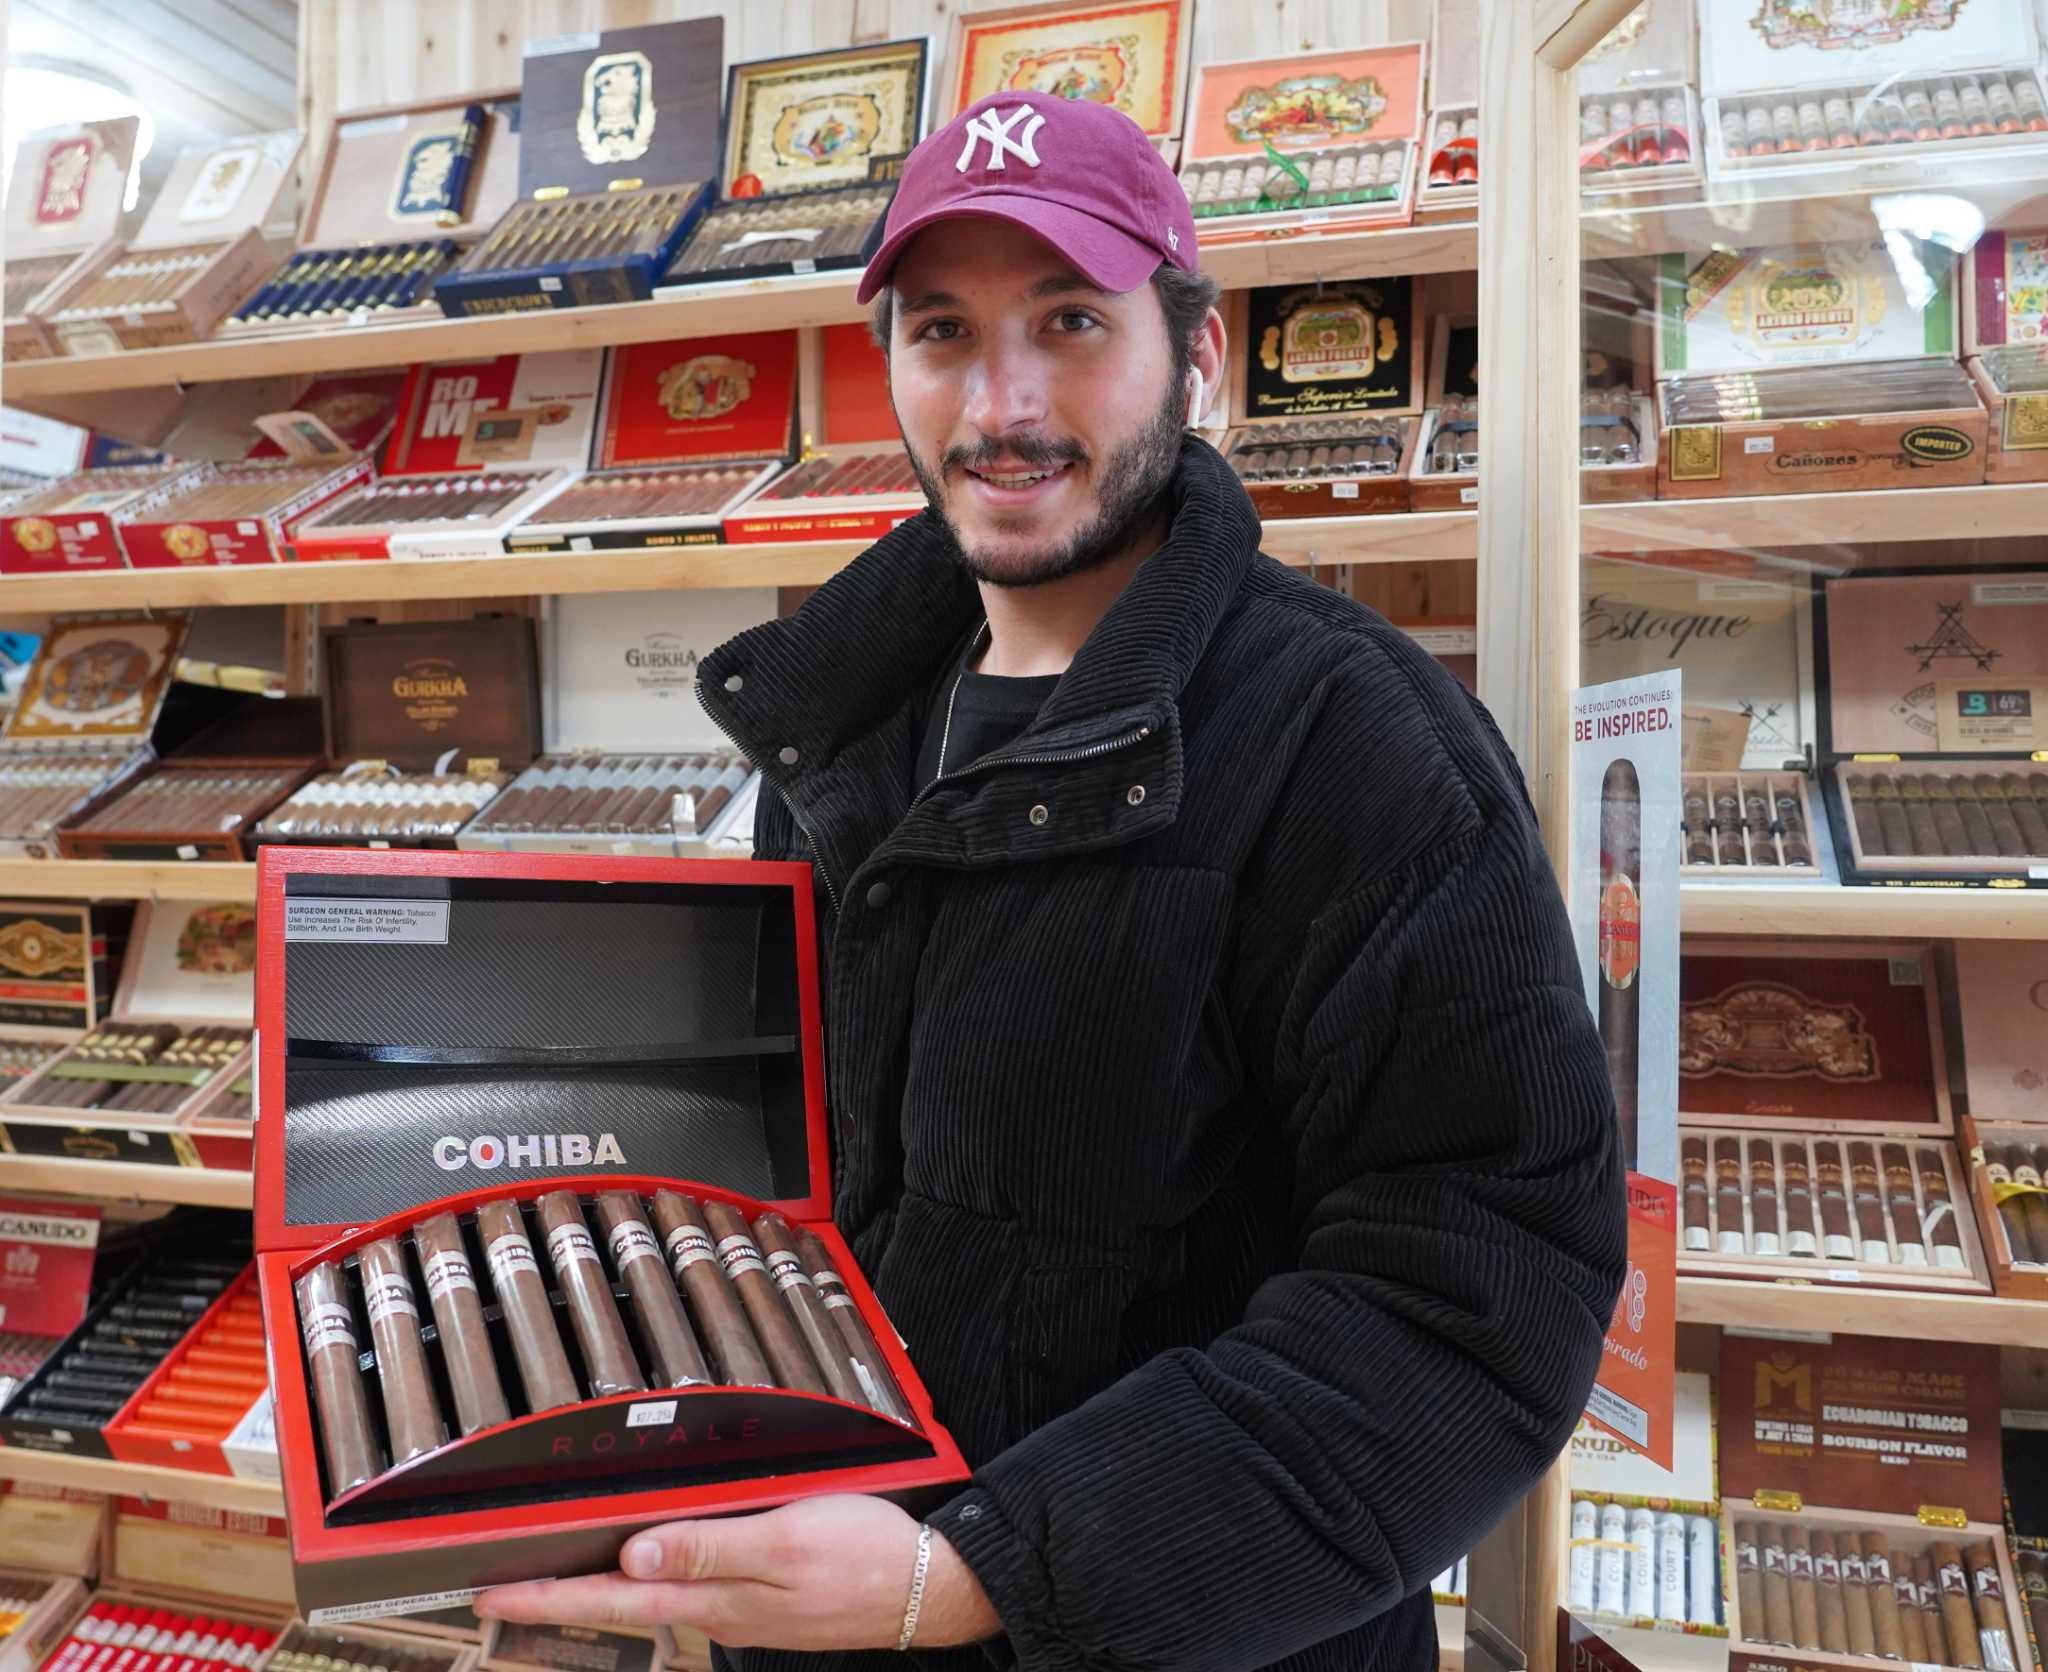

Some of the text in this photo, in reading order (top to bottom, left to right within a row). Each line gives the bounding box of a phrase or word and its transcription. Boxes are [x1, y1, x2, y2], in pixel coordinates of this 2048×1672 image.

[956, 104, 1046, 173] NY
[431, 375, 479, 401] RO
[1915, 437, 1961, 450] IMPORTED
[625, 648, 698, 667] GURKHA
[393, 674, 467, 698] GURKHA
[1575, 690, 1673, 715] THE EVOLUTION CONTINUES:
[1575, 707, 1672, 742] BE INSPIRED.
[288, 907, 326, 915] SURGEON
[406, 909, 437, 917] Tobacco
[304, 916, 340, 924] Increases
[356, 925, 373, 933] Birth
[432, 1133, 627, 1170] COHIBA
[1823, 1405, 1968, 1433] ECUADORIAN TOBACCO
[551, 1417, 761, 1457] ROYALE
[1822, 1434, 1967, 1459] BOURBON FLAVOR
[322, 1602, 381, 1616] SURGEON
[385, 1597, 440, 1608] GENERAL
